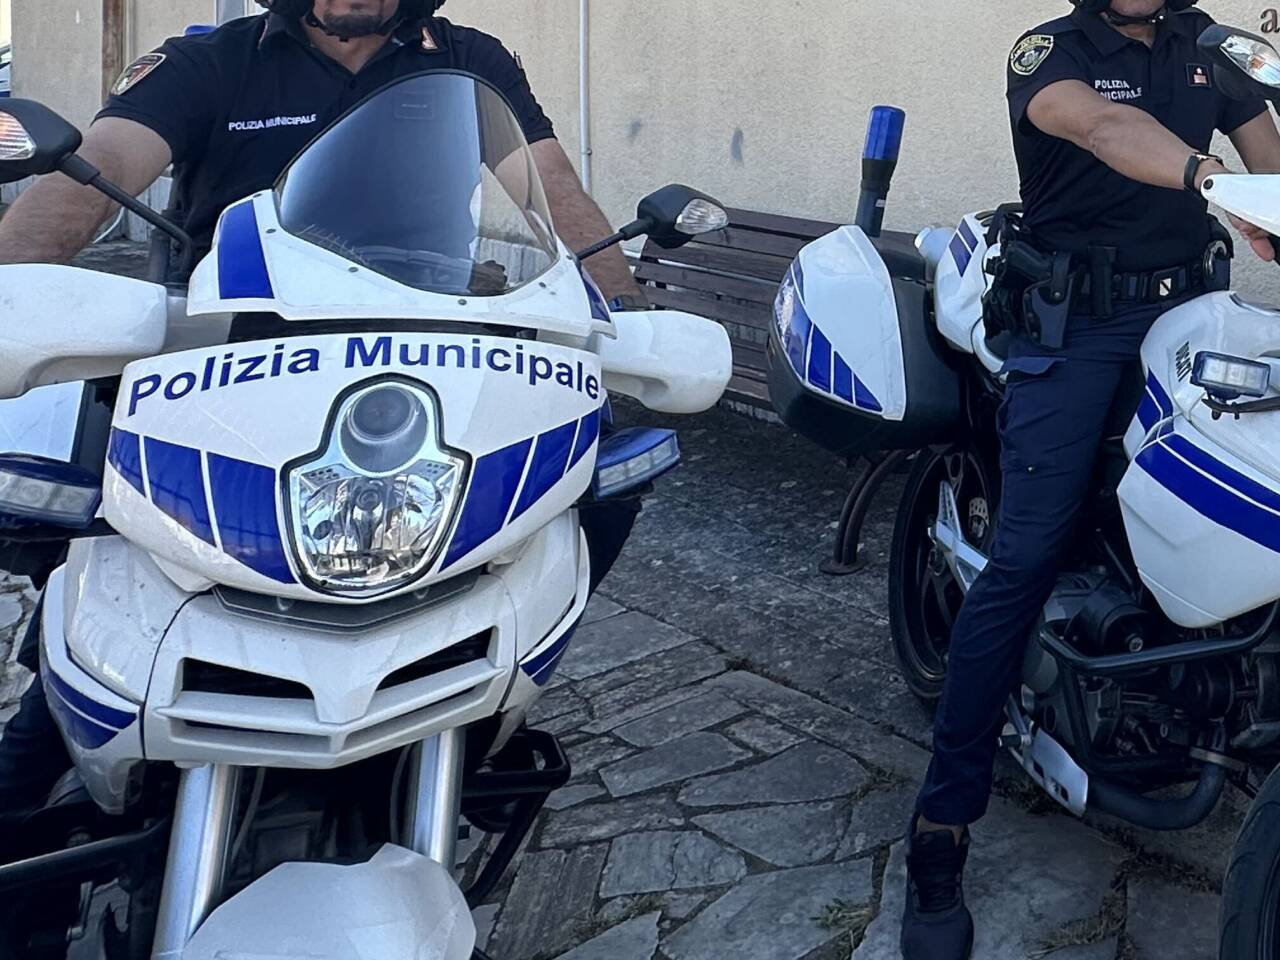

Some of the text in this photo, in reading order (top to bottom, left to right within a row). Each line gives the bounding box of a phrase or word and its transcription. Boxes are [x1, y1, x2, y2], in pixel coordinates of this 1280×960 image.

[1094, 79, 1130, 89] POLIZIA
[1101, 86, 1142, 101] NICIPALE
[228, 113, 317, 131] POLIZIA MUNICIPALE
[126, 336, 600, 418] Polizia Municipale
